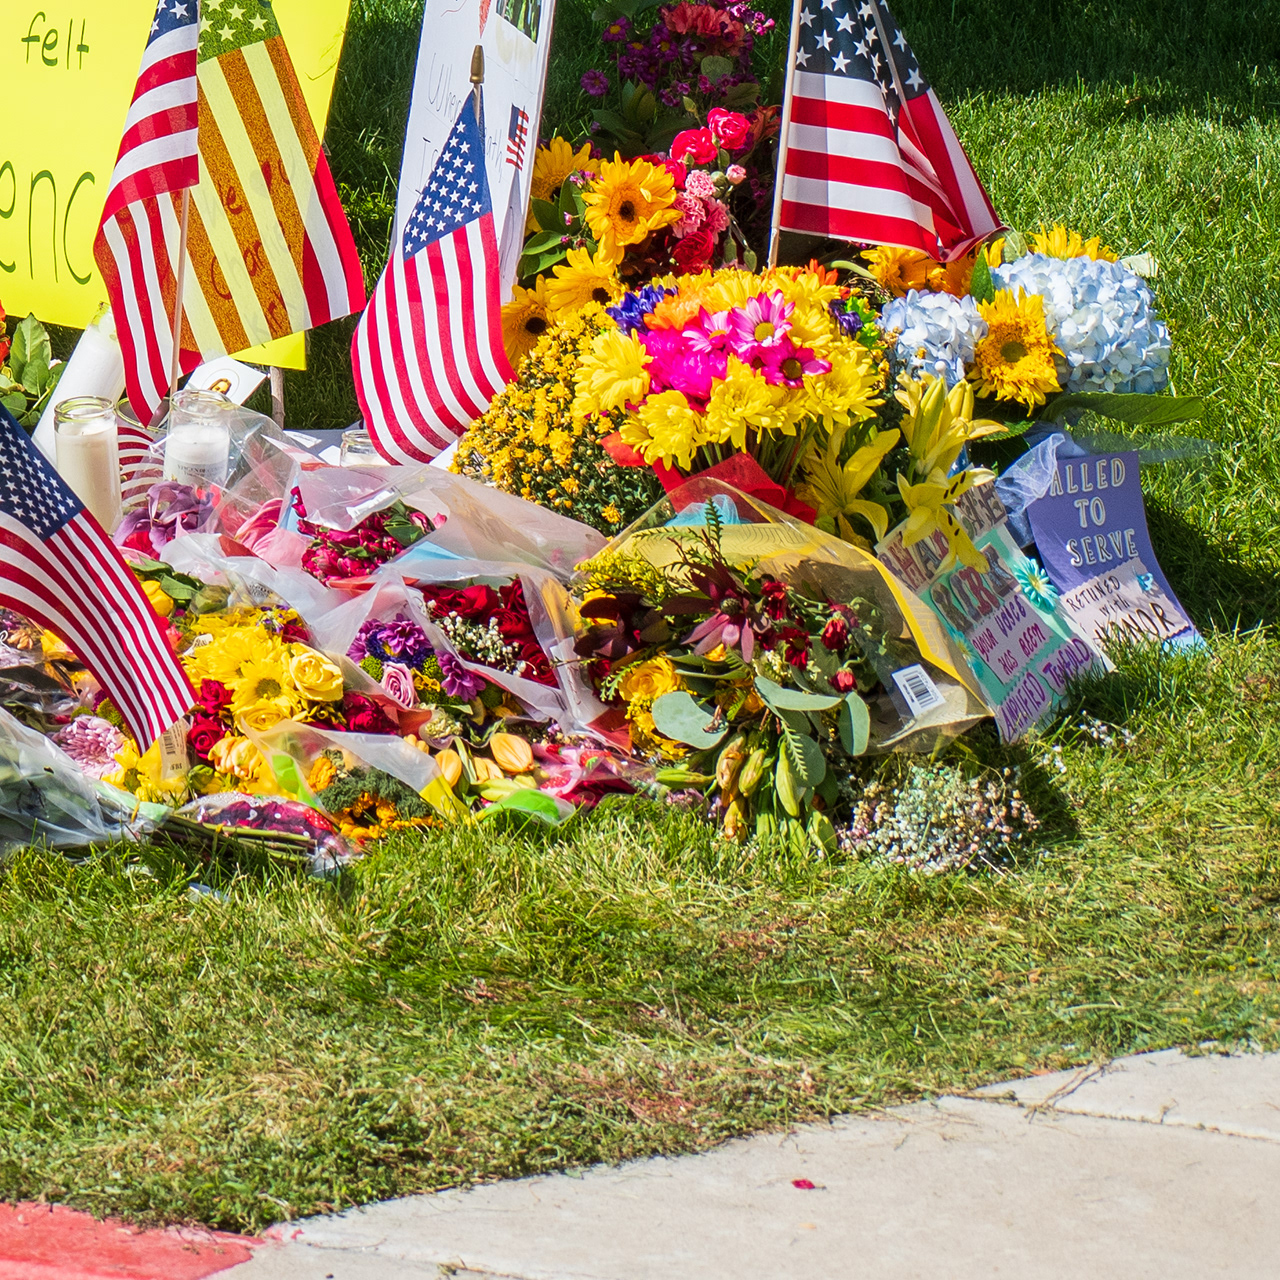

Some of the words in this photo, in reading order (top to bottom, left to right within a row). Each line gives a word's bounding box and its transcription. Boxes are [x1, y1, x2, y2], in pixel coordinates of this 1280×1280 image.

[21, 10, 89, 69] felt
[1049, 457, 1126, 497] ALLED
[1074, 496, 1106, 528] TO
[1066, 528, 1139, 567] SERVE
[1099, 596, 1131, 618] with
